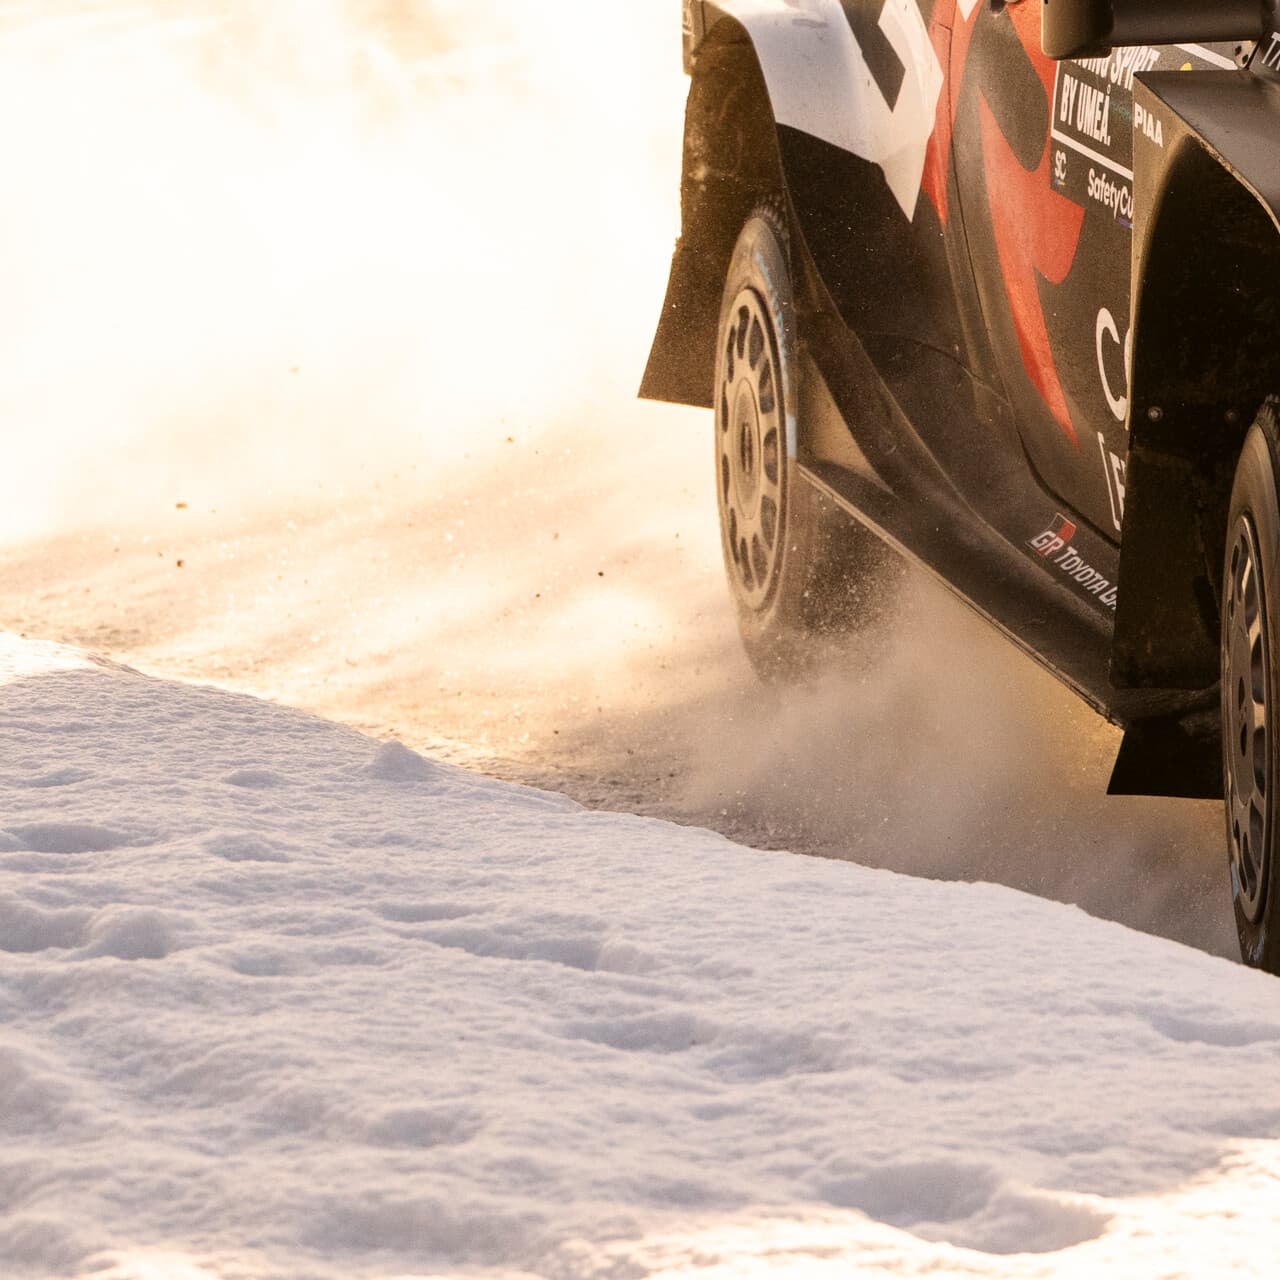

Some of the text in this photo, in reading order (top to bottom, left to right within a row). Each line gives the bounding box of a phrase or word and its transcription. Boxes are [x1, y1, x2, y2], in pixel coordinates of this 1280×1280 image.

[1060, 74, 1078, 126] BY
[1134, 102, 1164, 148] PIAA
[1053, 546, 1110, 600] TOYOTA
